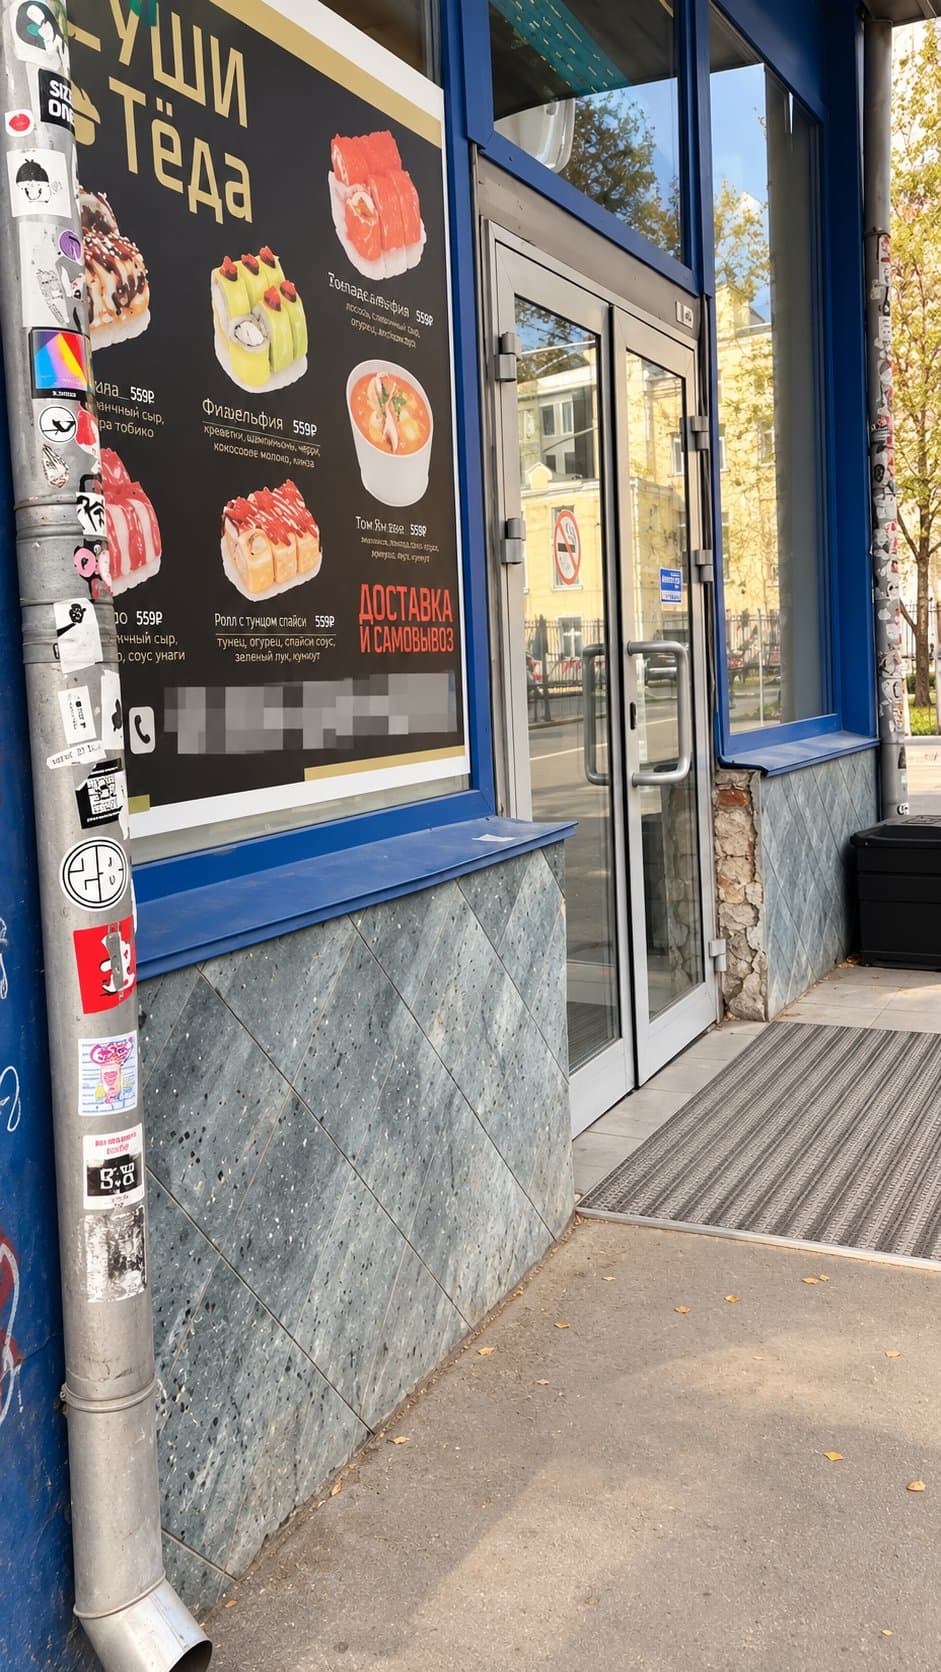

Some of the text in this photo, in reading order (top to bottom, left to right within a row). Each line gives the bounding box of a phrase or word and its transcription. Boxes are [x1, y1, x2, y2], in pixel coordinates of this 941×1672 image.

[48, 79, 73, 104] SIZ
[108, 76, 252, 224] Тёда
[99, 419, 154, 438] ра тобико
[355, 515, 373, 530] Том
[359, 583, 453, 625] ДОСТАВКА
[214, 612, 237, 627] Ролл
[239, 616, 245, 627] с
[245, 616, 278, 630] тунцом
[279, 614, 307, 628] спайси
[249, 638, 283, 650] огурец,
[373, 626, 454, 653] САМОВЫВОЗ
[128, 651, 153, 664] соус
[155, 651, 186, 664] унаги
